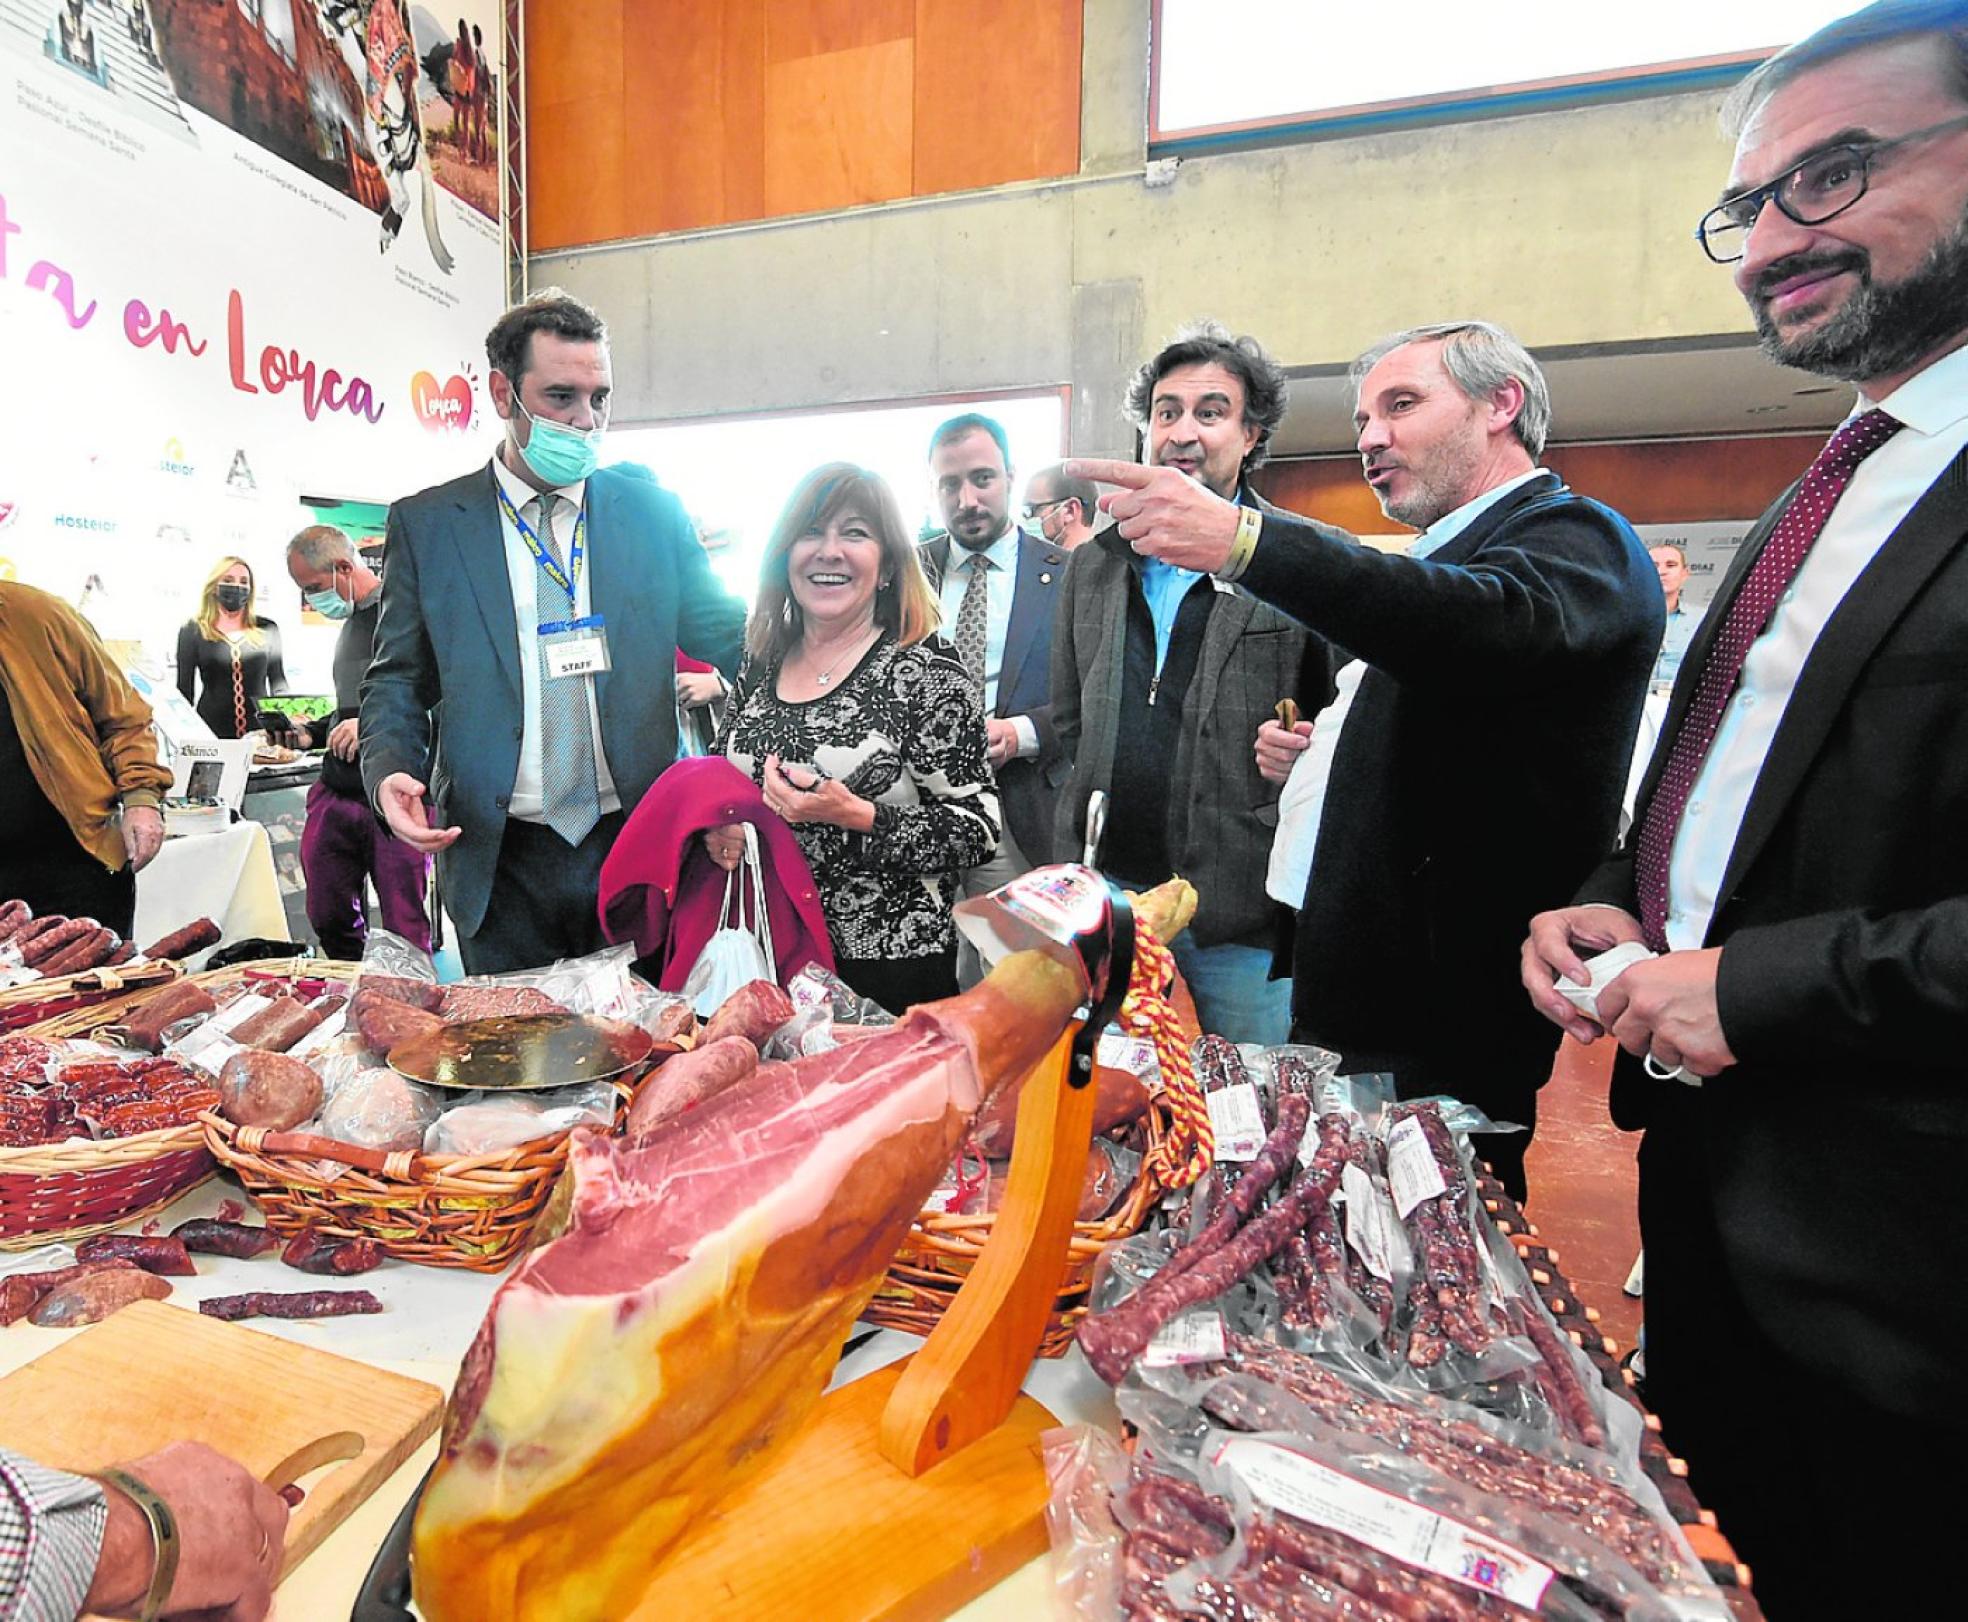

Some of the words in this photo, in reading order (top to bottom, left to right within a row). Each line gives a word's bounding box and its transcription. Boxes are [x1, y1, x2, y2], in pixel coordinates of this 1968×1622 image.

[123, 299, 208, 357] en
[227, 288, 385, 424] Lorca
[418, 386, 463, 422] Lorca
[561, 660, 593, 673] STAFF
